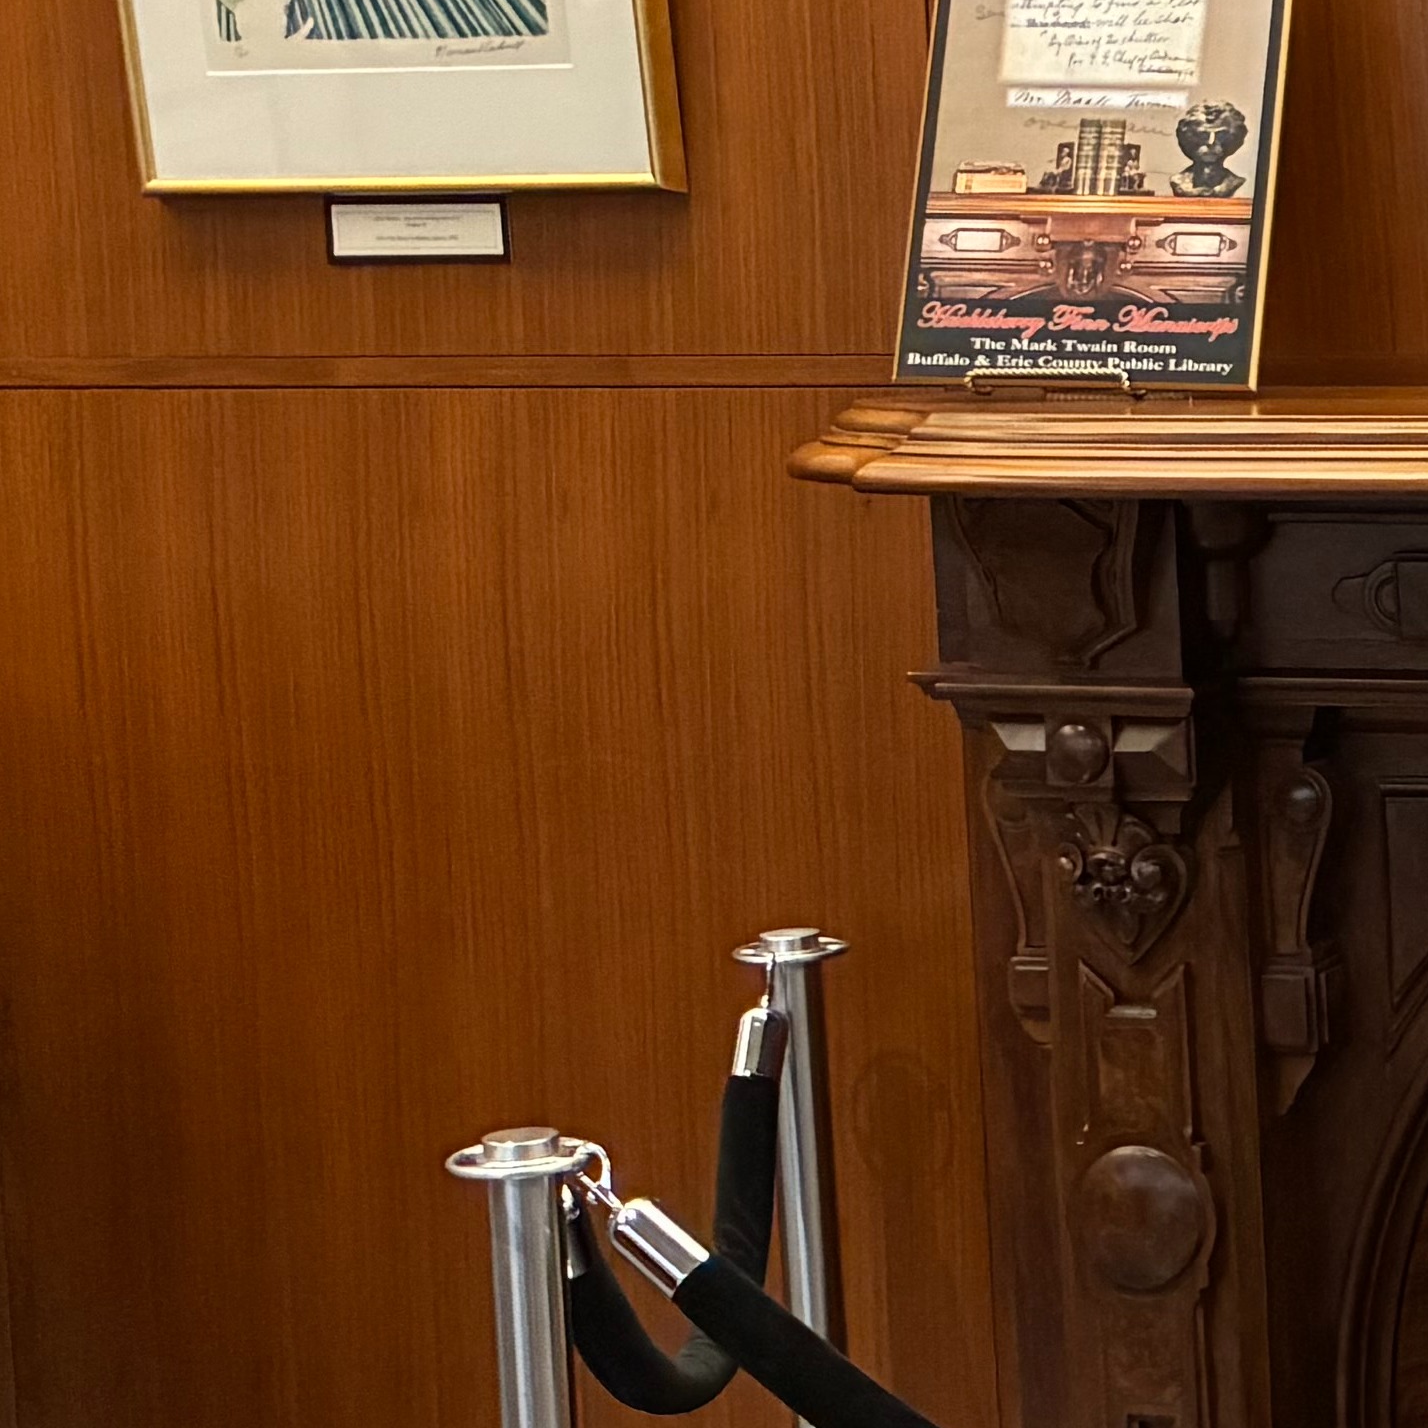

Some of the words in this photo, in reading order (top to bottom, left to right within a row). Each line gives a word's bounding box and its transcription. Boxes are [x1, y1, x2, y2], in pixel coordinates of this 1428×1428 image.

[1048, 304, 1111, 333] Finn
[970, 337, 1006, 351] The
[1010, 338, 1058, 353] Mark
[1061, 339, 1118, 354] Twain
[1122, 341, 1177, 355] Room
[907, 353, 970, 367] Buffalo
[974, 354, 991, 367] &
[996, 355, 1034, 368] Erie
[1037, 356, 1103, 371] County
[1106, 357, 1164, 372] Public
[1168, 358, 1233, 375] Library
